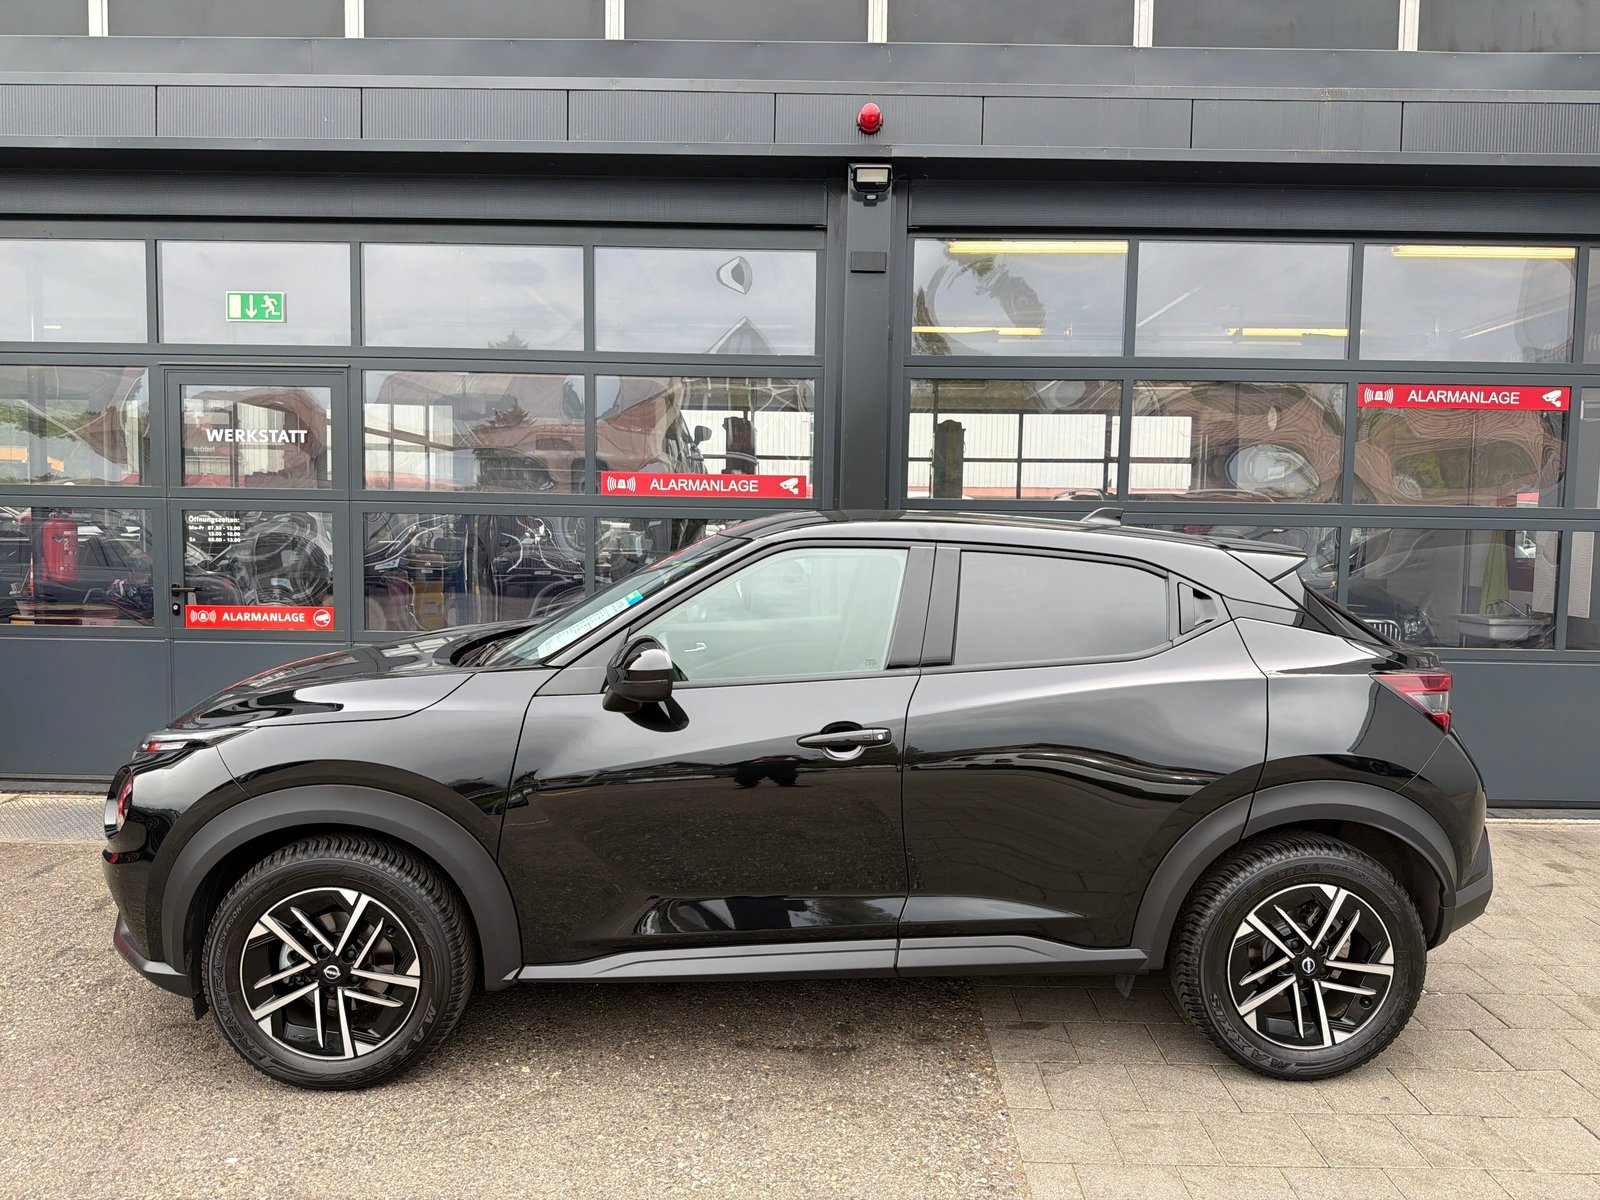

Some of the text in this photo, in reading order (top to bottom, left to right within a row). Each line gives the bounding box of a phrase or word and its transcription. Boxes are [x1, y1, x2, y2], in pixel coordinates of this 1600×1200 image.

[1407, 389, 1521, 405] ALARMANLAGE
[205, 428, 308, 444] WERKSTATT
[649, 478, 759, 492] ALARMANLAGE
[221, 612, 306, 623] ALARMANLAGE
[1209, 993, 1292, 1071] MAXXIS
